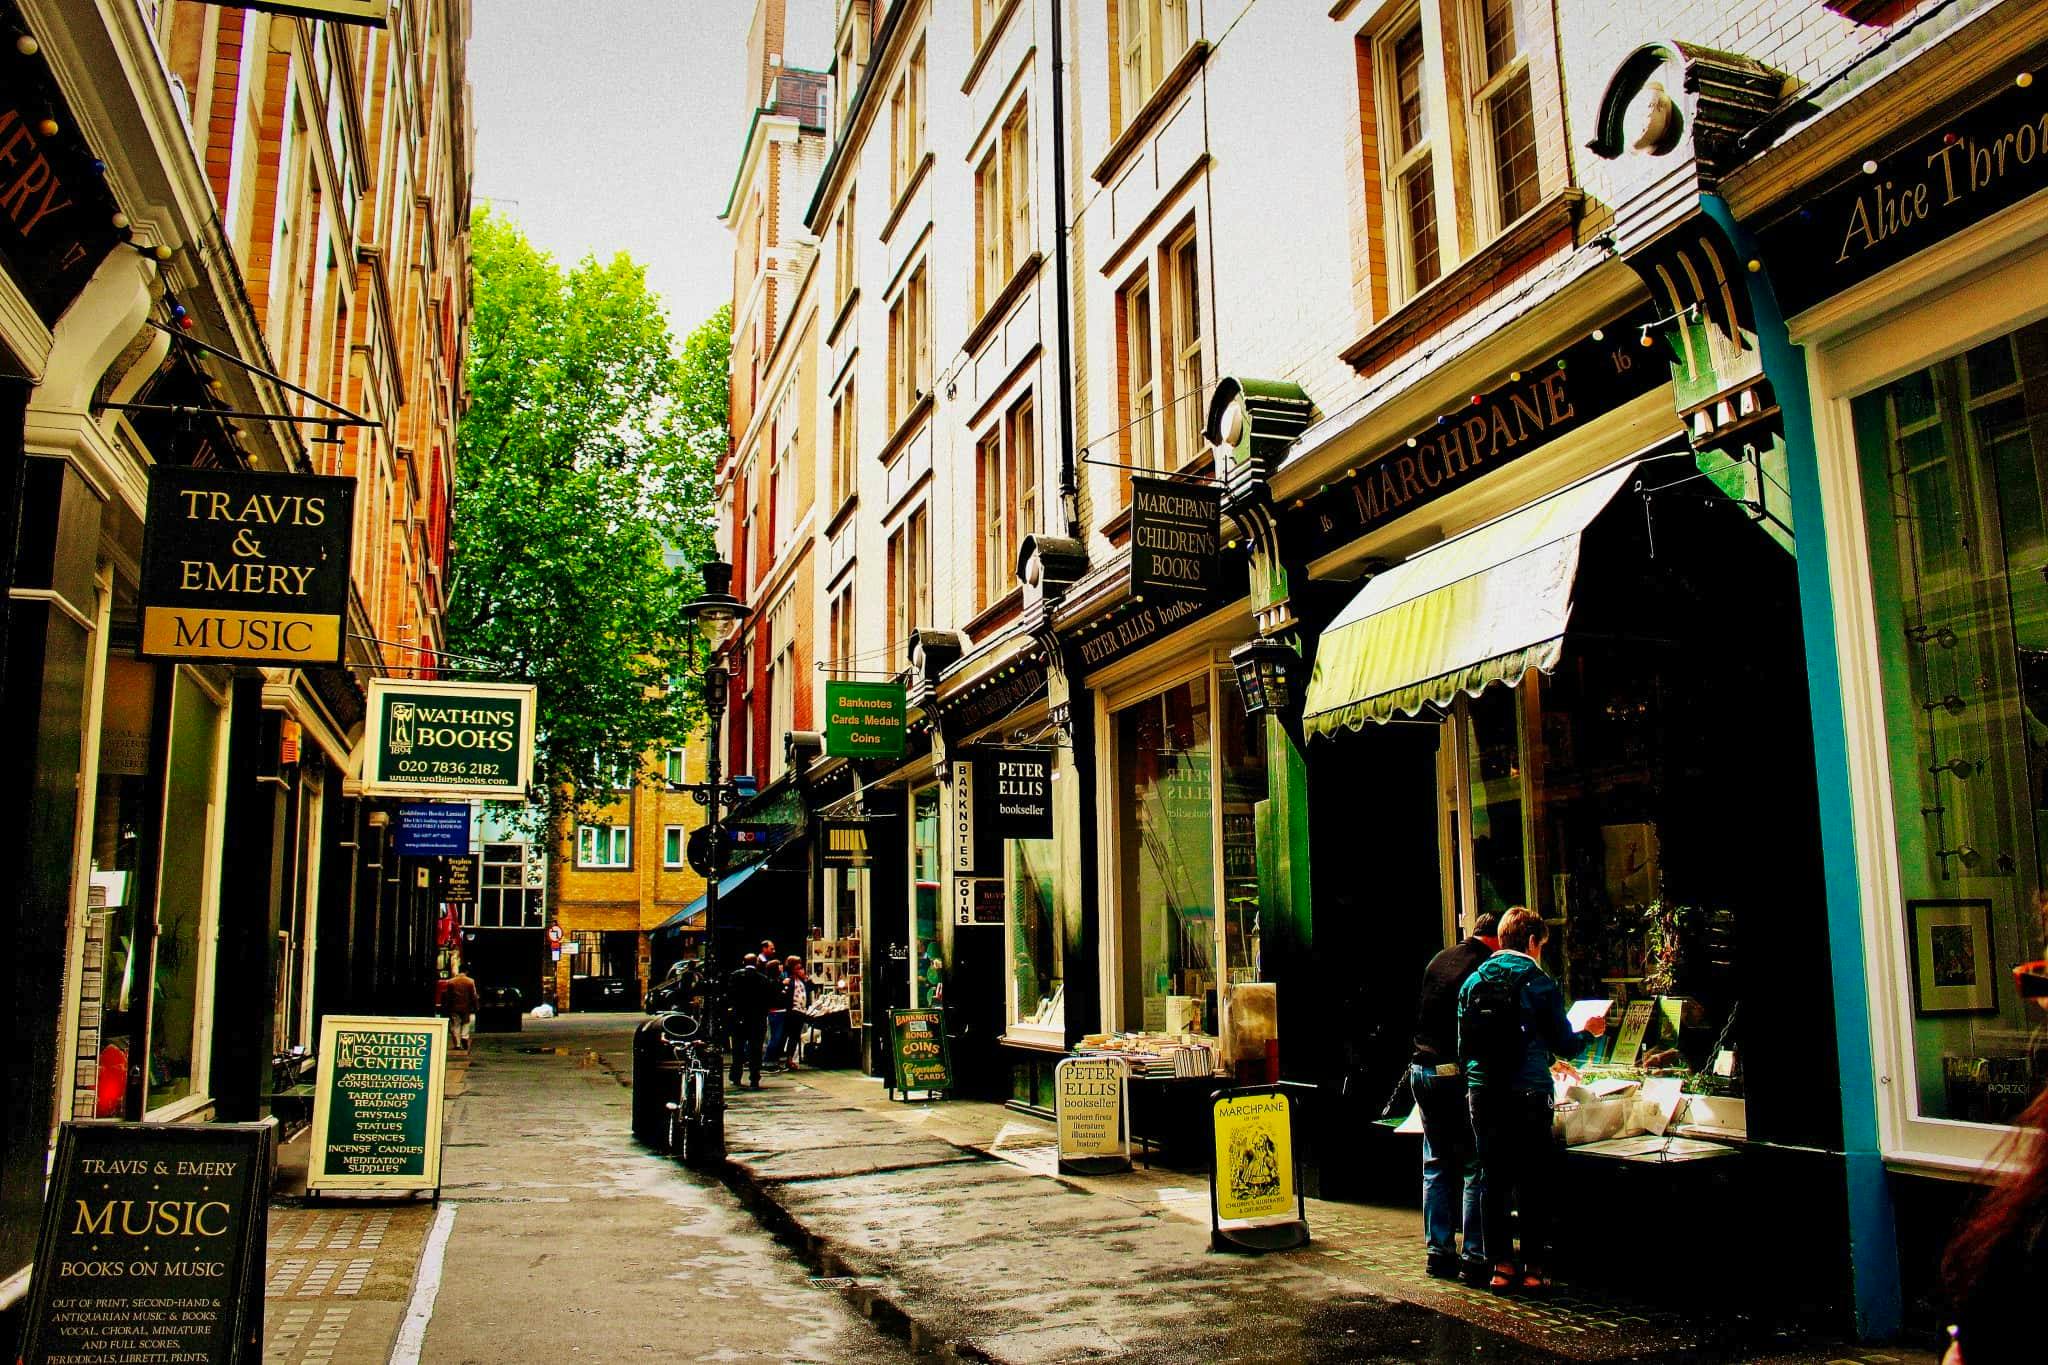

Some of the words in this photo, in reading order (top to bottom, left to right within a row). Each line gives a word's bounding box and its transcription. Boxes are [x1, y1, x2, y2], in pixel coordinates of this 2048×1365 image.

[1835, 181, 1929, 264] Alice
[1319, 512, 1335, 533] 16
[1351, 369, 1574, 525] MARCHPANE
[1611, 351, 1632, 374] 16
[180, 489, 326, 527] TRAVIS
[1137, 491, 1217, 521] MARCHPANE
[231, 528, 267, 559] &
[1136, 526, 1216, 556] CHILDREN'S
[1151, 554, 1201, 581] BOOKS
[179, 560, 316, 596] EMERY
[173, 616, 313, 652] MUSIC
[1080, 631, 1120, 665] PETER
[1116, 609, 1156, 647] ELLIS
[838, 696, 893, 709] Banknotes
[416, 708, 515, 728] WATKINS
[831, 713, 860, 725] Cards
[864, 714, 900, 726] Medals
[416, 727, 514, 752] BOOKS
[850, 732, 881, 744] Coins
[398, 760, 428, 773] 020
[431, 761, 467, 775] 7836
[469, 763, 500, 775] 2182
[998, 762, 1045, 778] PETER
[389, 774, 509, 786] www.watkinsbooks.com
[999, 780, 1044, 796] ELLIS
[958, 765, 969, 867] BANKNOTES
[1000, 803, 1045, 816] bookseller
[960, 879, 970, 924] COINS
[895, 1014, 939, 1026] BANKNOTES
[354, 1033, 427, 1047] WATKINS
[354, 1045, 427, 1057] ESOTERIC
[903, 1042, 940, 1054] COINS
[353, 1057, 424, 1070] CENTRE
[342, 1073, 424, 1082] ASTROLOGICAL
[918, 1072, 946, 1081] CARDS
[1065, 1067, 1116, 1081] PETER
[337, 1080, 425, 1090] CONSULTATIONS
[1065, 1082, 1117, 1096] ELLIS
[347, 1091, 383, 1101] TAROT
[385, 1092, 416, 1101] CARD
[354, 1099, 409, 1109] READINGS
[1064, 1098, 1117, 1108] bookseller
[1219, 1101, 1284, 1118] MARCHPANE
[354, 1111, 408, 1120] CRYSTALS
[1067, 1113, 1093, 1121] modern
[356, 1122, 403, 1131] STATUES
[1073, 1122, 1105, 1130] literature
[353, 1133, 406, 1142] ESSENCES
[1072, 1131, 1107, 1139] illustrated
[328, 1144, 372, 1153] INCENSE
[378, 1145, 424, 1154] CANDLES
[343, 1156, 407, 1165] MEDITATION
[82, 1159, 148, 1175] TRAVIS
[154, 1160, 170, 1175] &
[176, 1162, 237, 1177] EMERY
[348, 1164, 400, 1174] SUPPLIES
[71, 1199, 231, 1237] MUSIC
[60, 1261, 124, 1277] BOOKS
[129, 1261, 158, 1277] ON
[164, 1261, 225, 1277] MUSIC
[52, 1298, 76, 1309] OUT
[78, 1298, 93, 1308] OF
[132, 1298, 210, 1308] SECOND-HAND
[211, 1298, 221, 1308] &
[51, 1311, 130, 1323] ANTIQUARIAN
[132, 1312, 167, 1321] MUSIC
[169, 1312, 178, 1321] &
[152, 1325, 212, 1335] MINIATURE
[81, 1340, 108, 1350] AND
[110, 1340, 139, 1349] FULL
